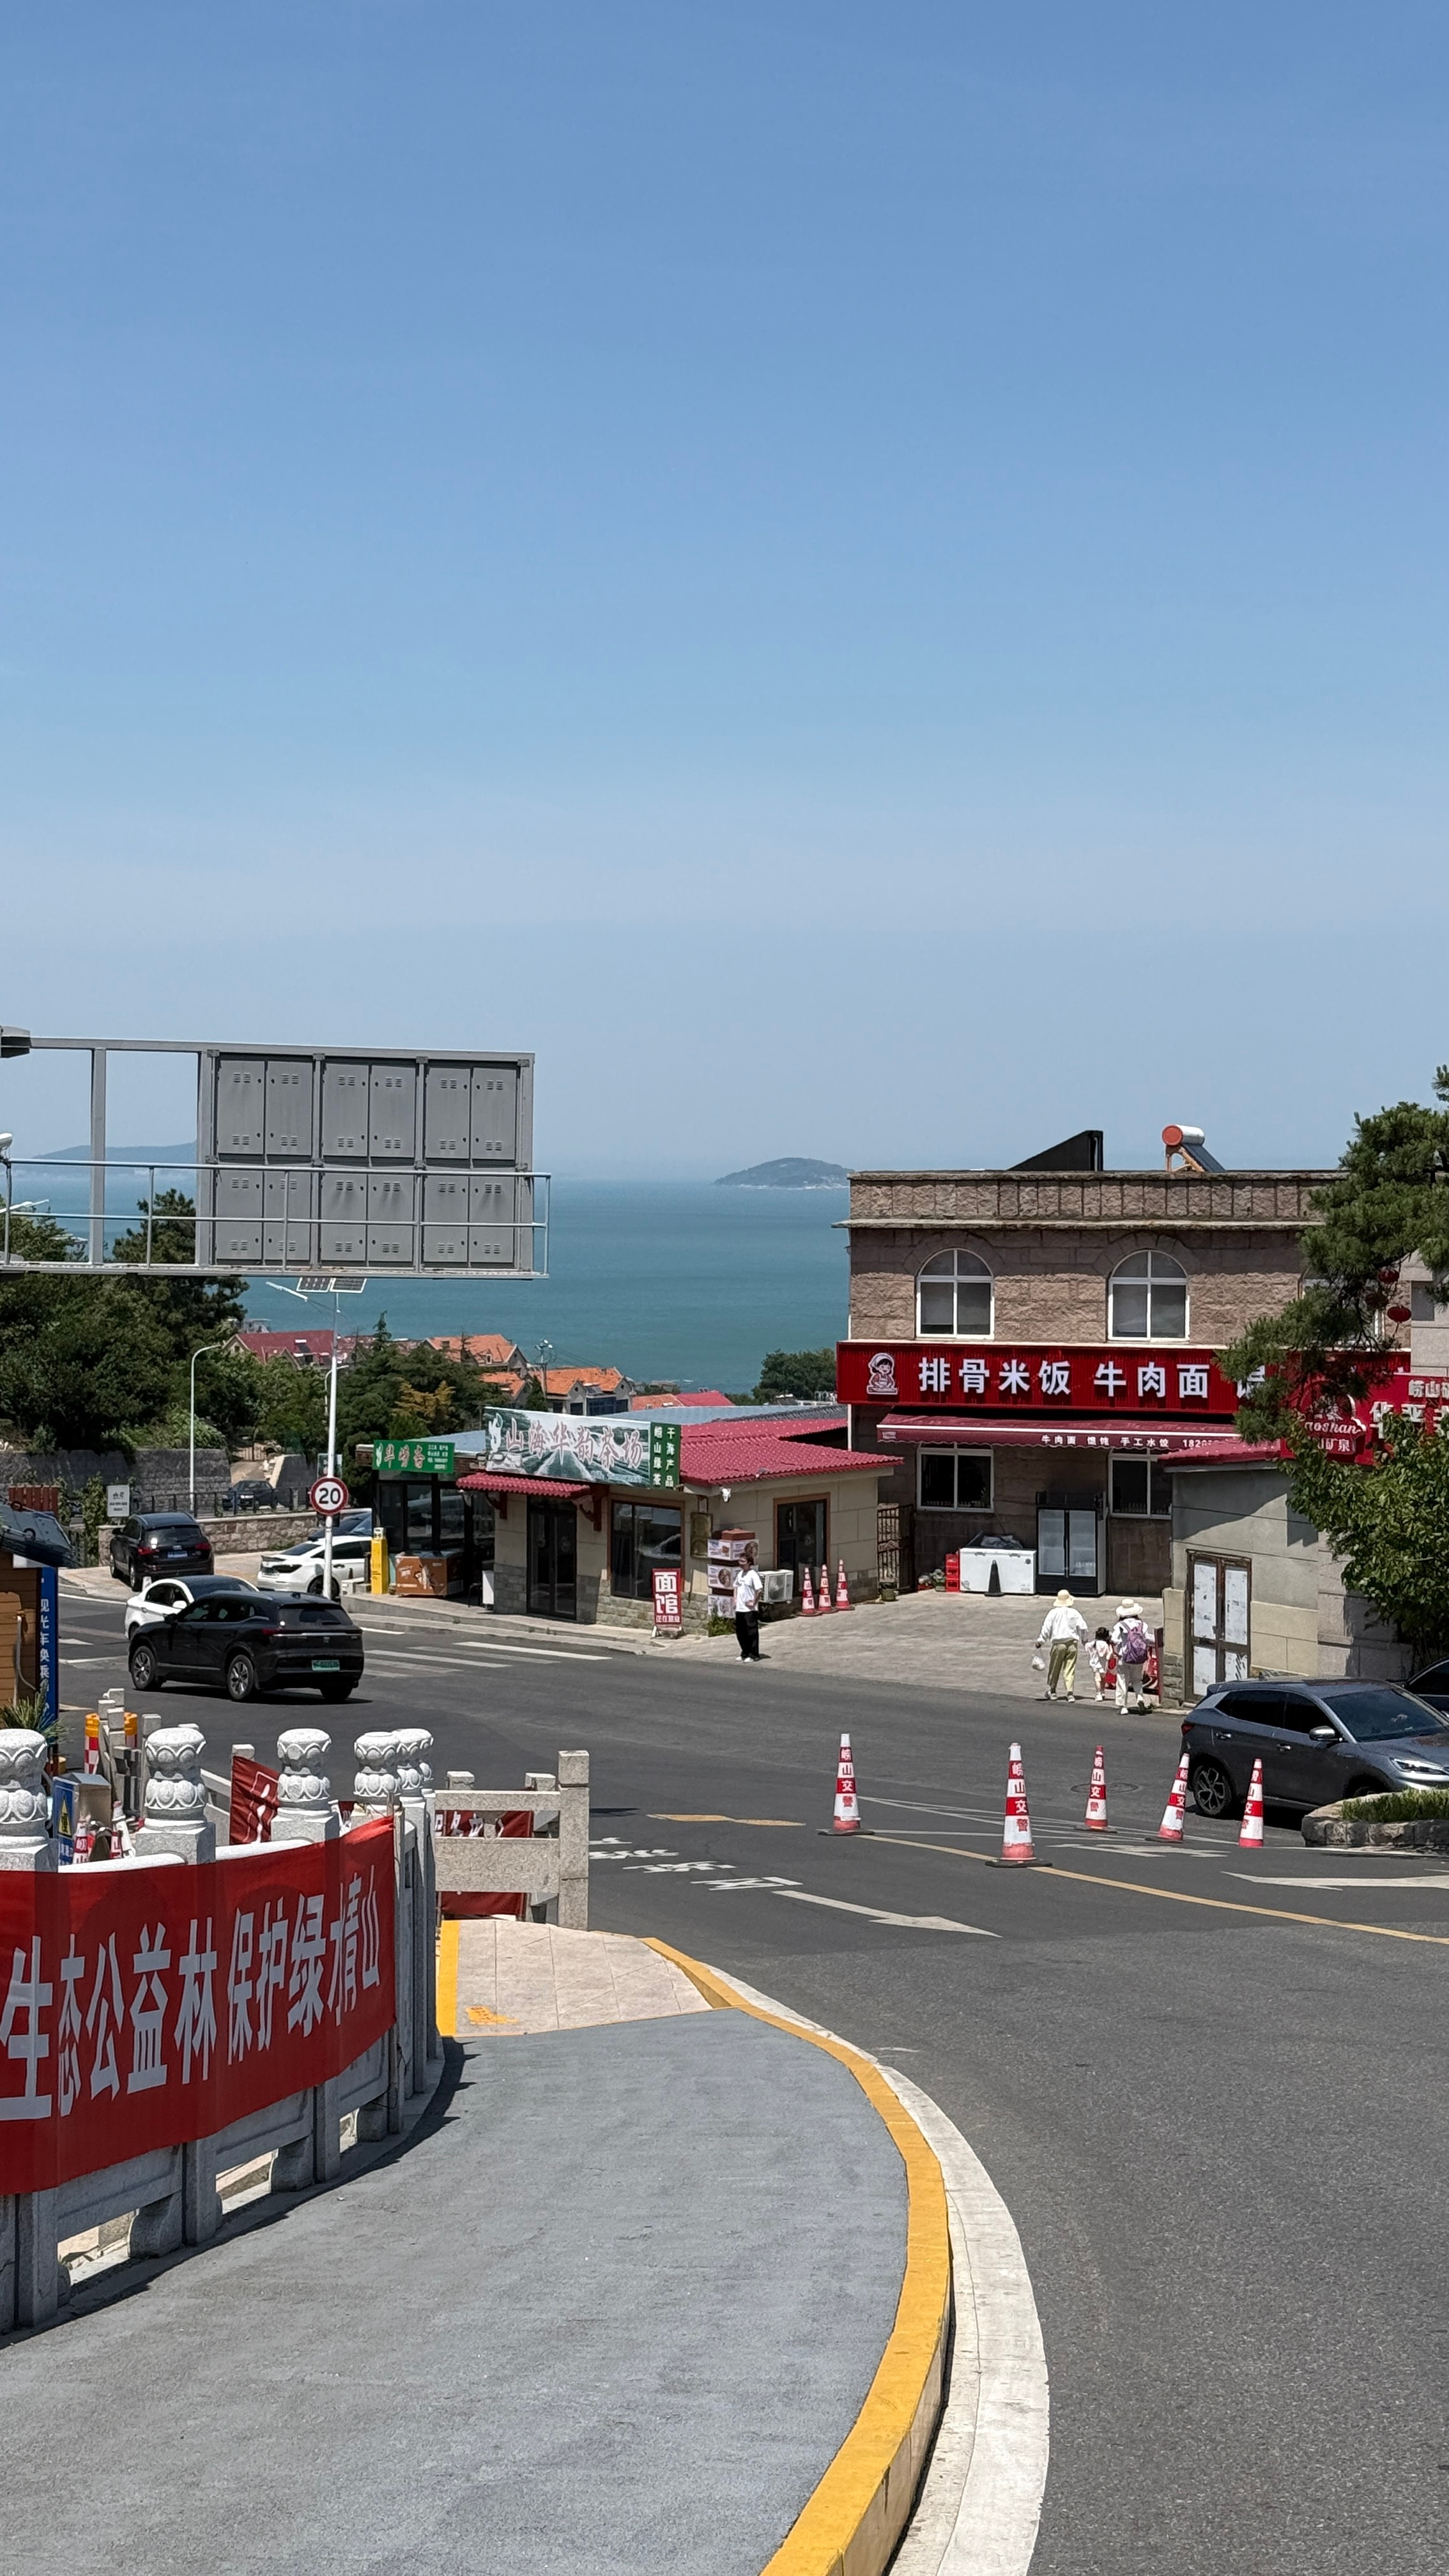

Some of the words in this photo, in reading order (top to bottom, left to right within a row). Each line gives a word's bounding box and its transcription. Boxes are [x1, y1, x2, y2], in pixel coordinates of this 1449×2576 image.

[918, 1356, 1071, 1395] 排骨米饭
[1093, 1360, 1211, 1399] 牛肉面
[505, 1416, 644, 1470] 山海华韵茶场
[664, 1427, 675, 1488] 干海产品
[1041, 1435, 1077, 1445] 牛肉面
[1087, 1436, 1110, 1446] 馄饨
[1119, 1437, 1170, 1448] 手工水饺
[319, 1487, 341, 1505] 20
[654, 1572, 678, 1614] 面馆
[840, 1747, 854, 1809] 崂山交警
[1011, 1761, 1029, 1832] 崂山交警
